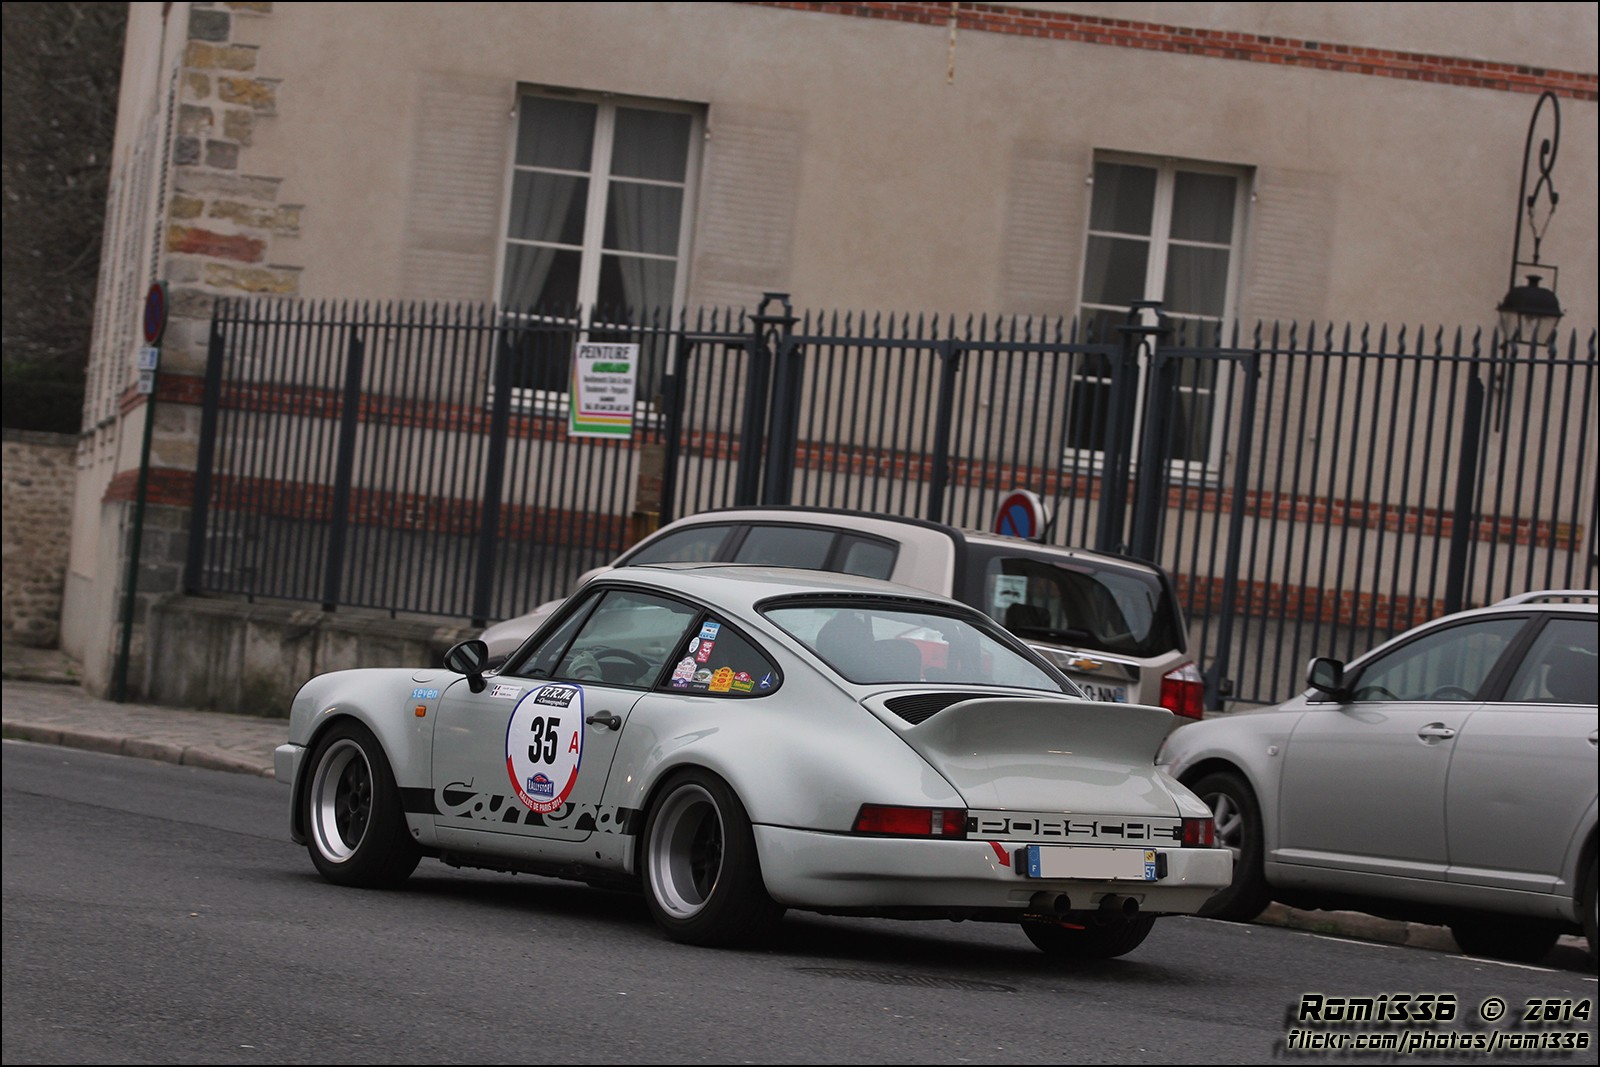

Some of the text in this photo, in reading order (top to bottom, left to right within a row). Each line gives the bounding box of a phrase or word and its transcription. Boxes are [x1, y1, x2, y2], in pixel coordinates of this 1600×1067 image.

[580, 345, 630, 360] PEINTURE
[412, 688, 439, 699] seven
[528, 716, 561, 765] 35
[568, 731, 579, 754] A
[434, 777, 626, 835] Carrera
[518, 790, 562, 812] RALLYE DE PARIS 2014
[978, 817, 1174, 841] PORSCHE
[1031, 864, 1037, 872] F
[1145, 866, 1156, 878] 57
